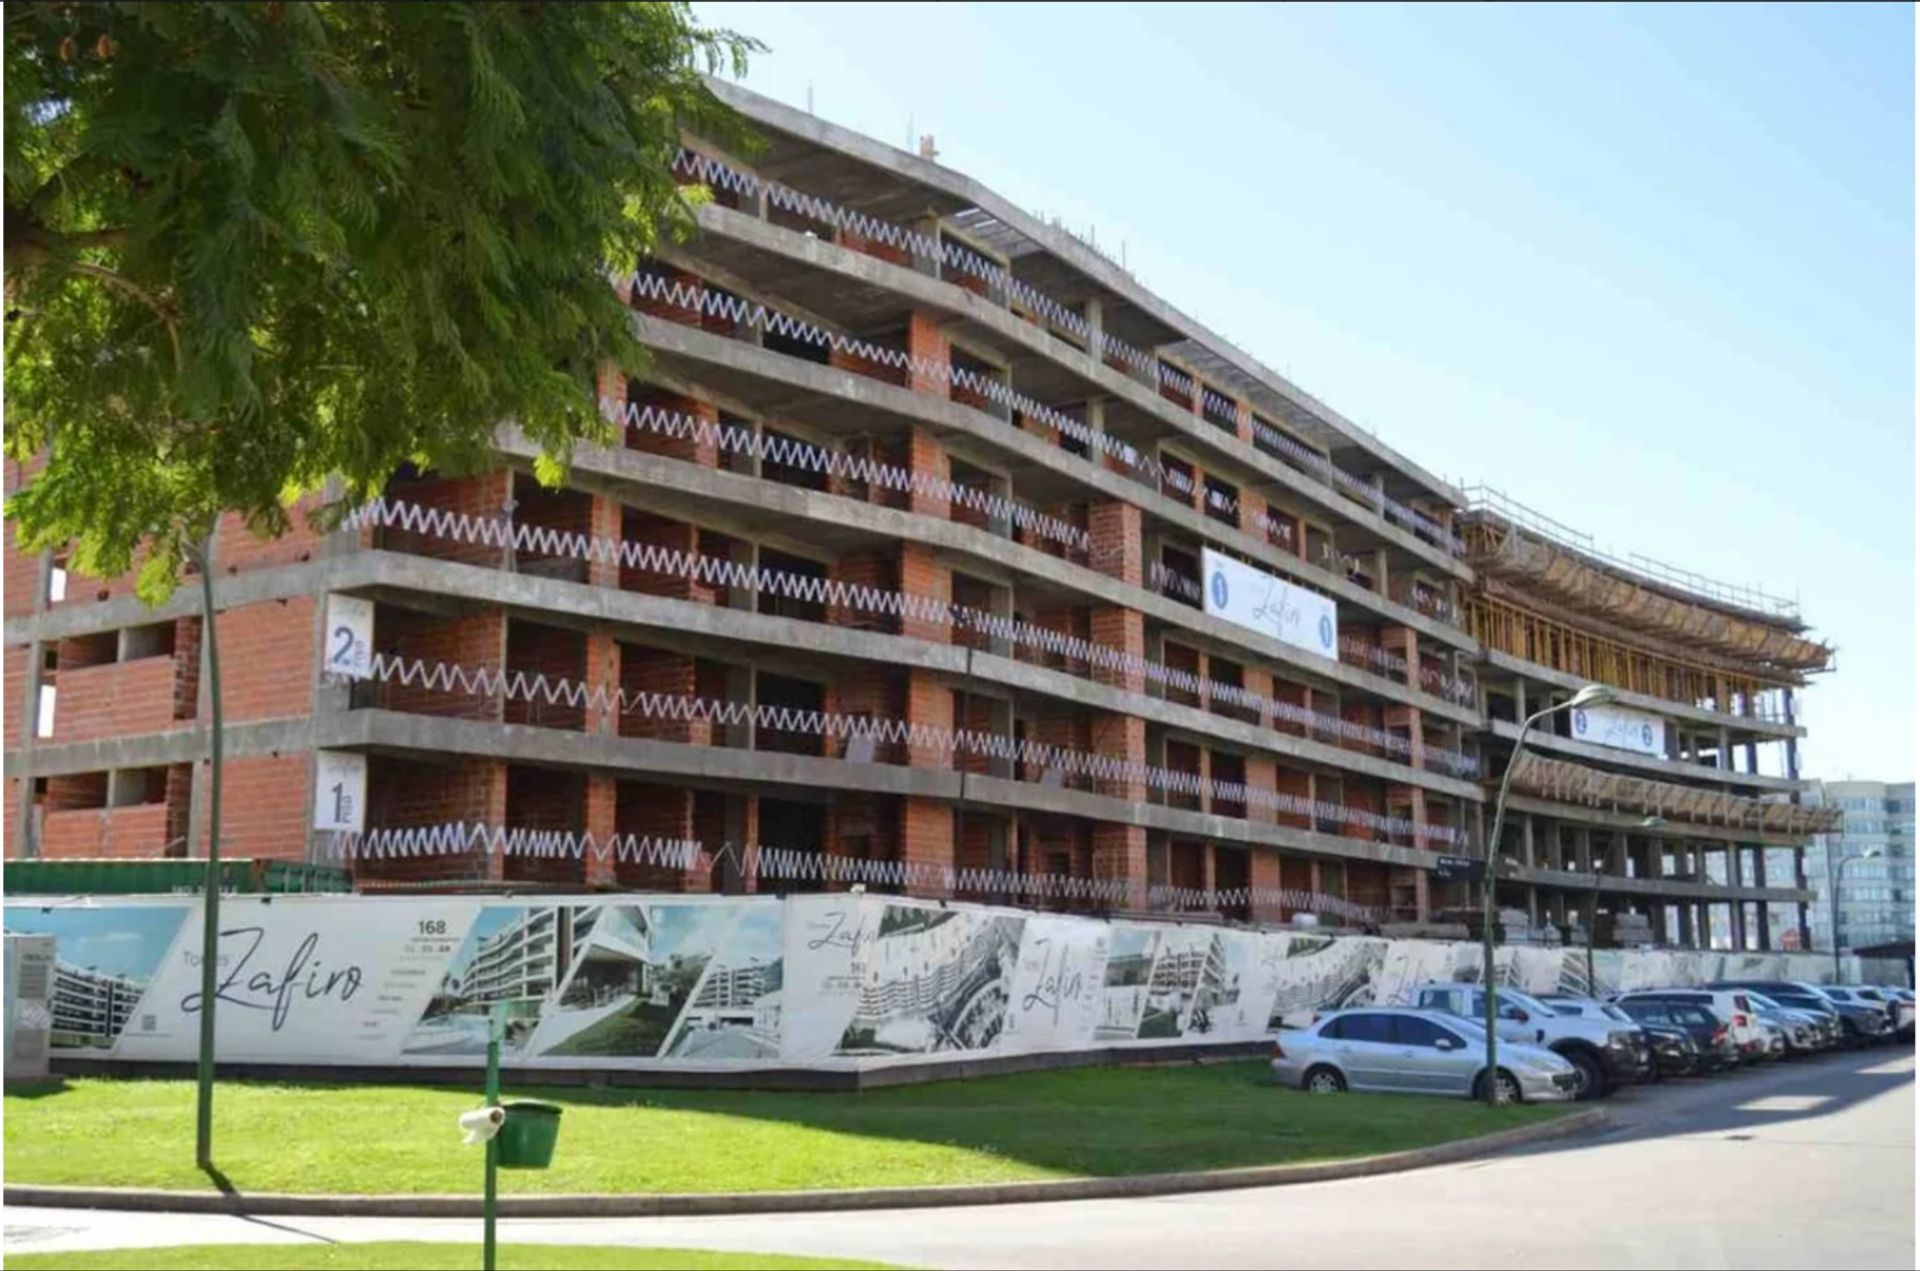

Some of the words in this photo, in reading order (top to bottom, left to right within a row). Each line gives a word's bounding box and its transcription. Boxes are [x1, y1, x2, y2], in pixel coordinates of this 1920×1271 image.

[333, 625, 354, 664] 2
[331, 782, 343, 823] 1
[418, 919, 448, 936] 168
[180, 926, 364, 1032] Zafiro
